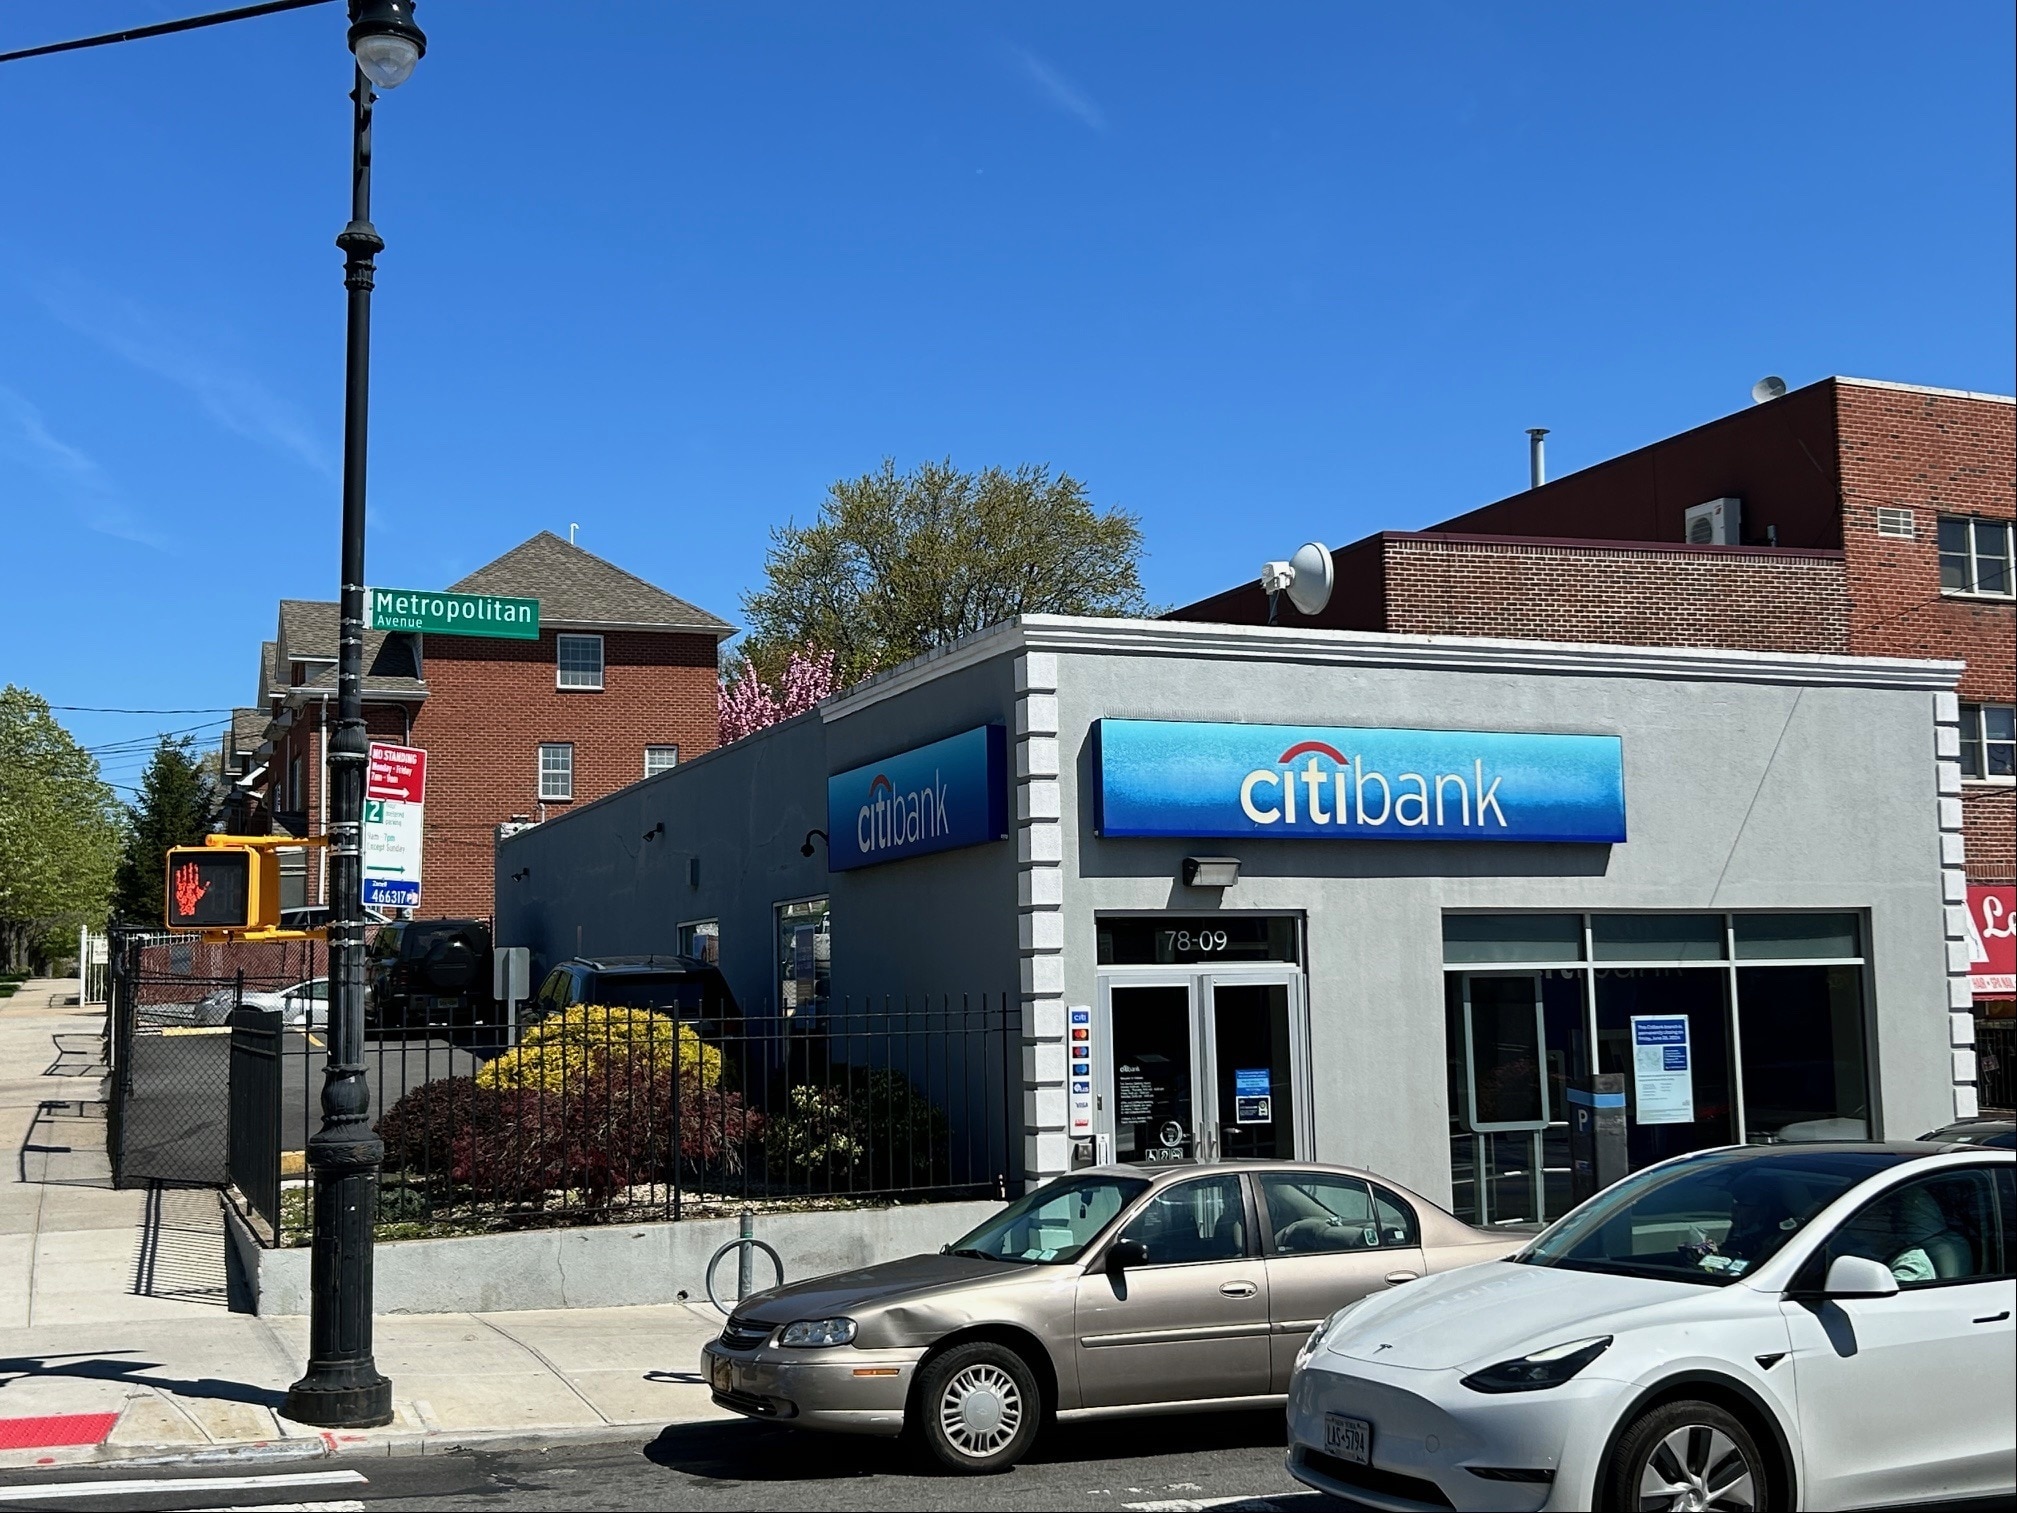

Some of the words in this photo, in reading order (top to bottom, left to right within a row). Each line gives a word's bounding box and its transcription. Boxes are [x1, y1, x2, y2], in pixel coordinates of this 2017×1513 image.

[377, 592, 531, 623] Metropolitan
[377, 614, 423, 628] Avenue
[372, 748, 383, 760] NO
[384, 750, 418, 765] STANDING
[1240, 741, 1508, 828] citibank
[369, 800, 380, 821] 2
[857, 768, 950, 853] citibank
[371, 889, 407, 904] 466317
[1164, 930, 1227, 951] 78-09
[1073, 1013, 1087, 1021] citi
[1577, 1108, 1589, 1132] P
